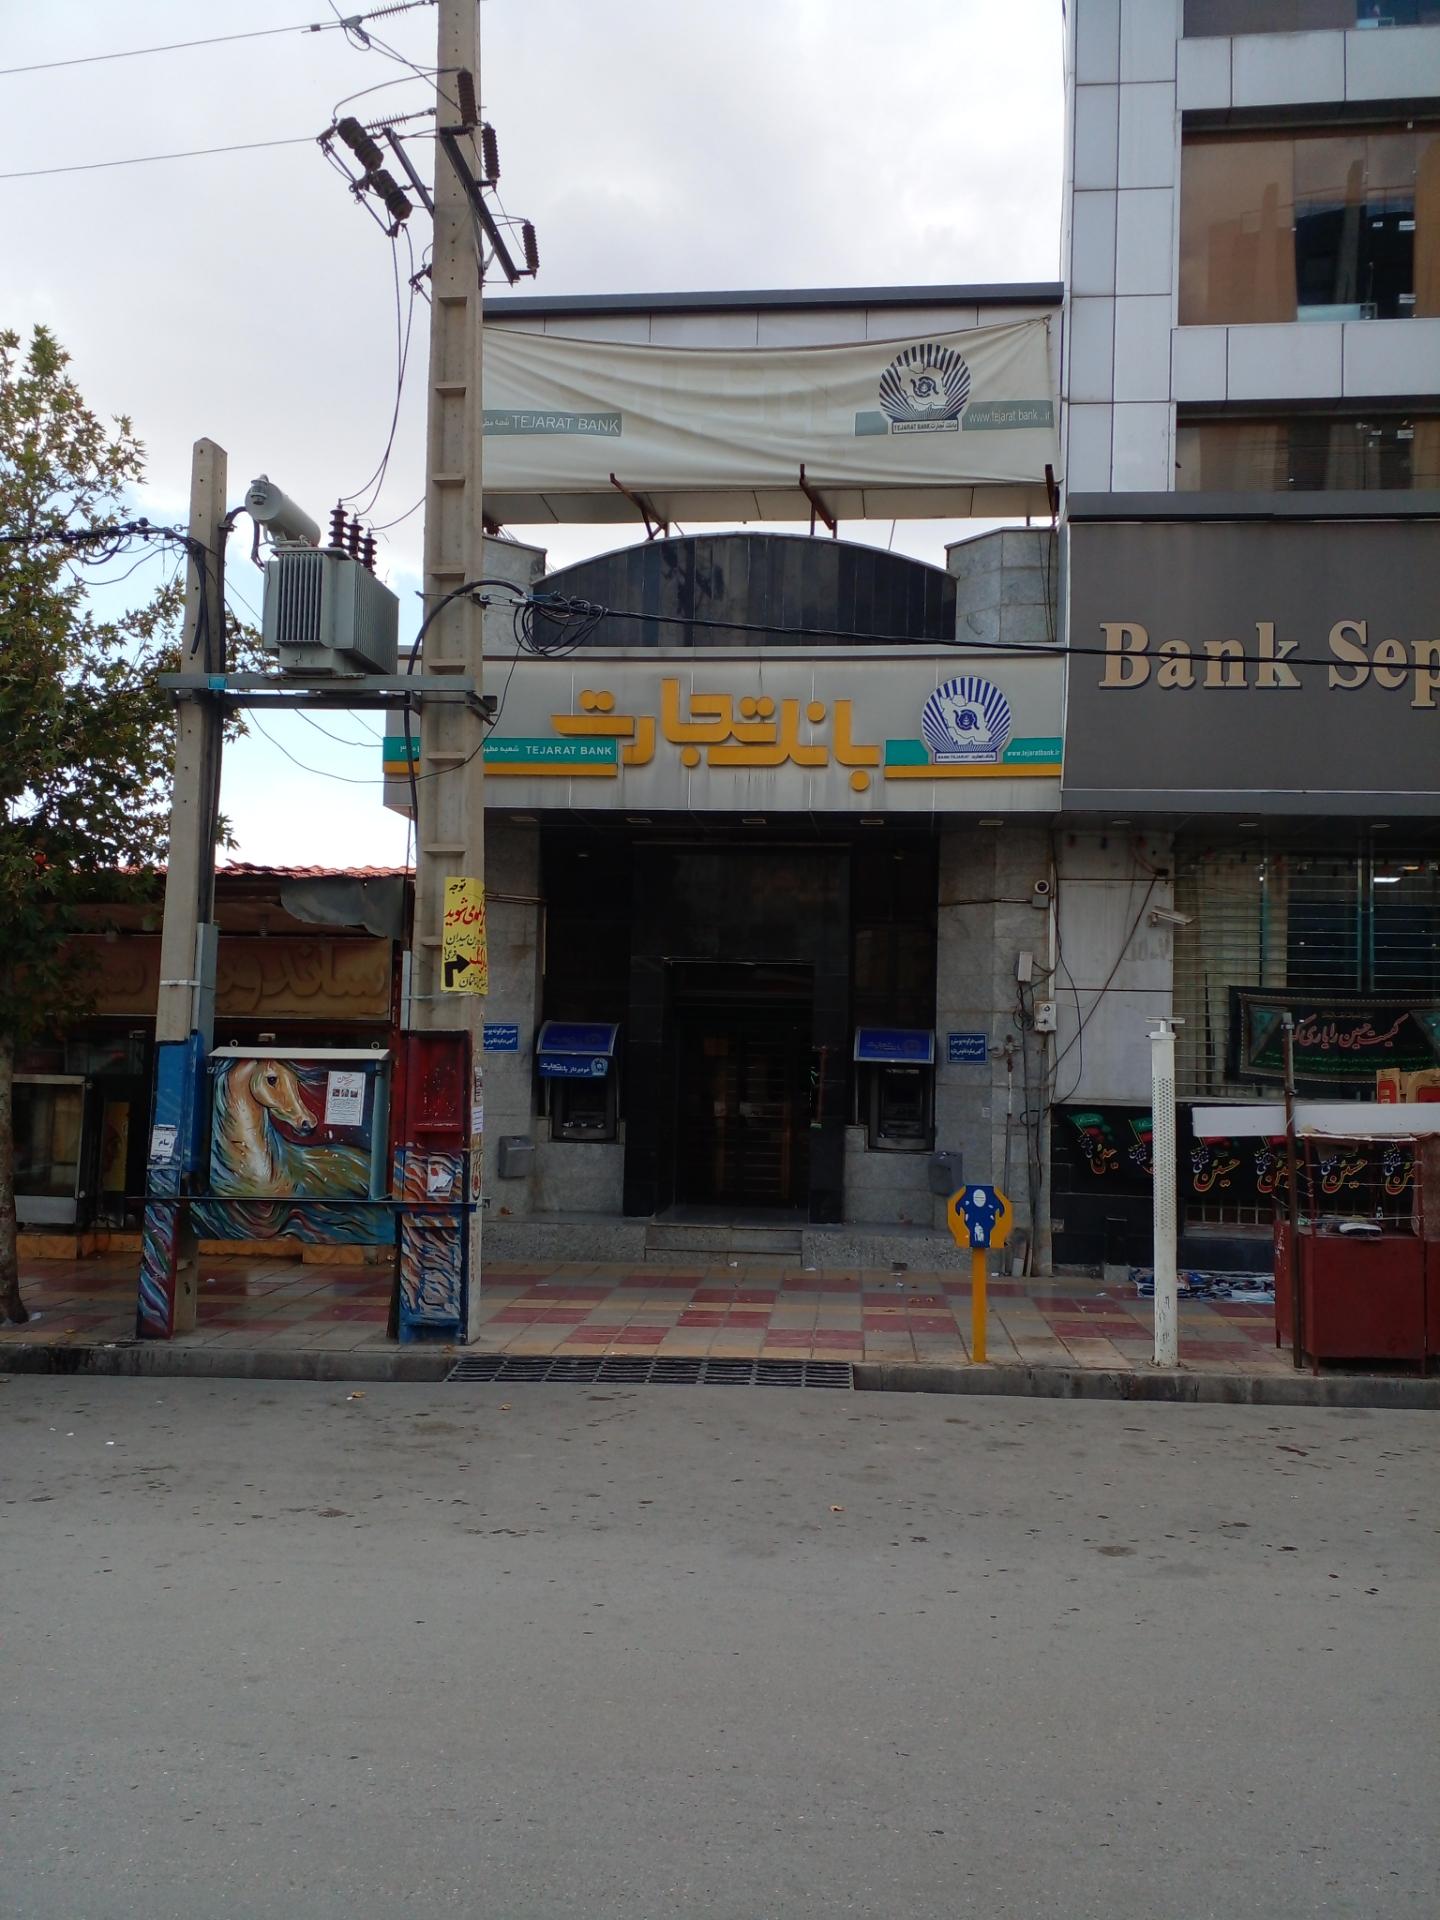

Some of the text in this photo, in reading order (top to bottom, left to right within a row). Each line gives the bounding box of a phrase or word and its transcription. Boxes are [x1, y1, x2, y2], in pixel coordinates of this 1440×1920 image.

[511, 415, 619, 433] TEJARAT BANK
[1098, 621, 1303, 688] Bank
[526, 745, 613, 756] TEJARAT BANK
[550, 678, 881, 792] بانک تجارت
[1193, 1158, 1241, 1192] حسین
